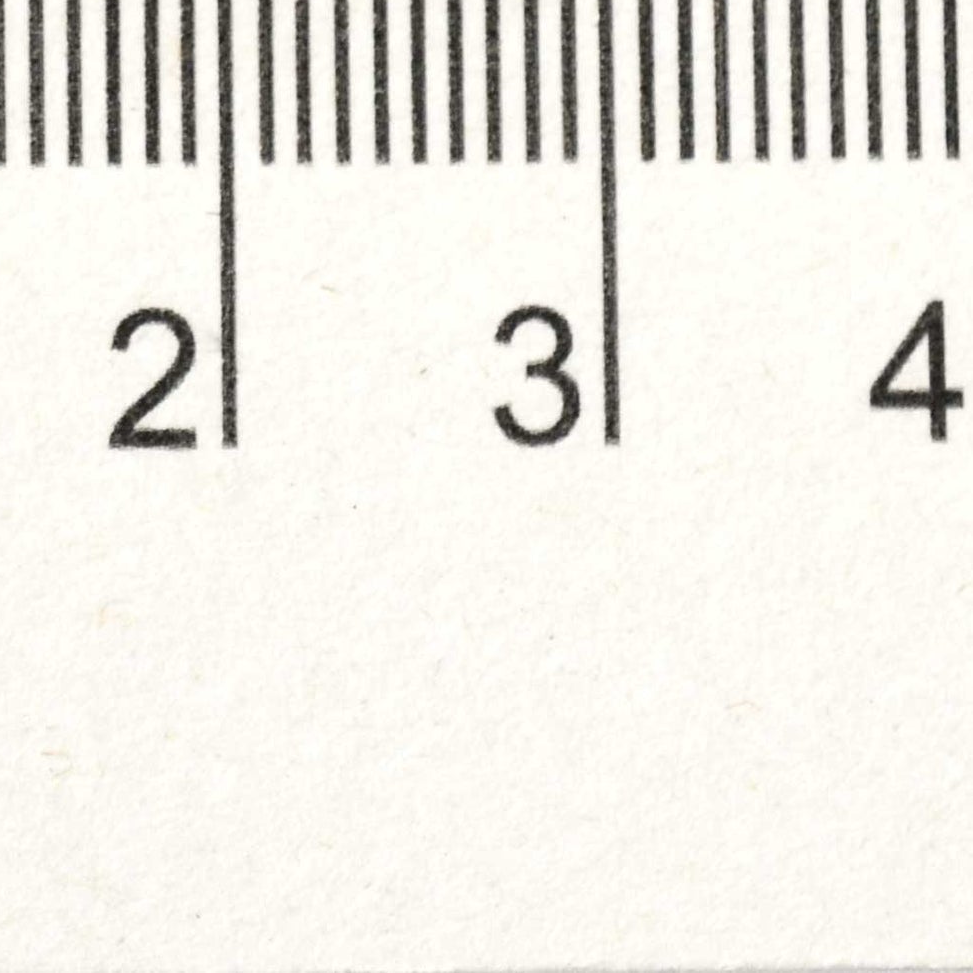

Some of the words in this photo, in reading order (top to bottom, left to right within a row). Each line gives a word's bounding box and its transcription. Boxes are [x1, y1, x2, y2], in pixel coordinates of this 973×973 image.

[109, 307, 197, 449] 2
[494, 305, 581, 447] 3
[869, 299, 964, 441] 4
